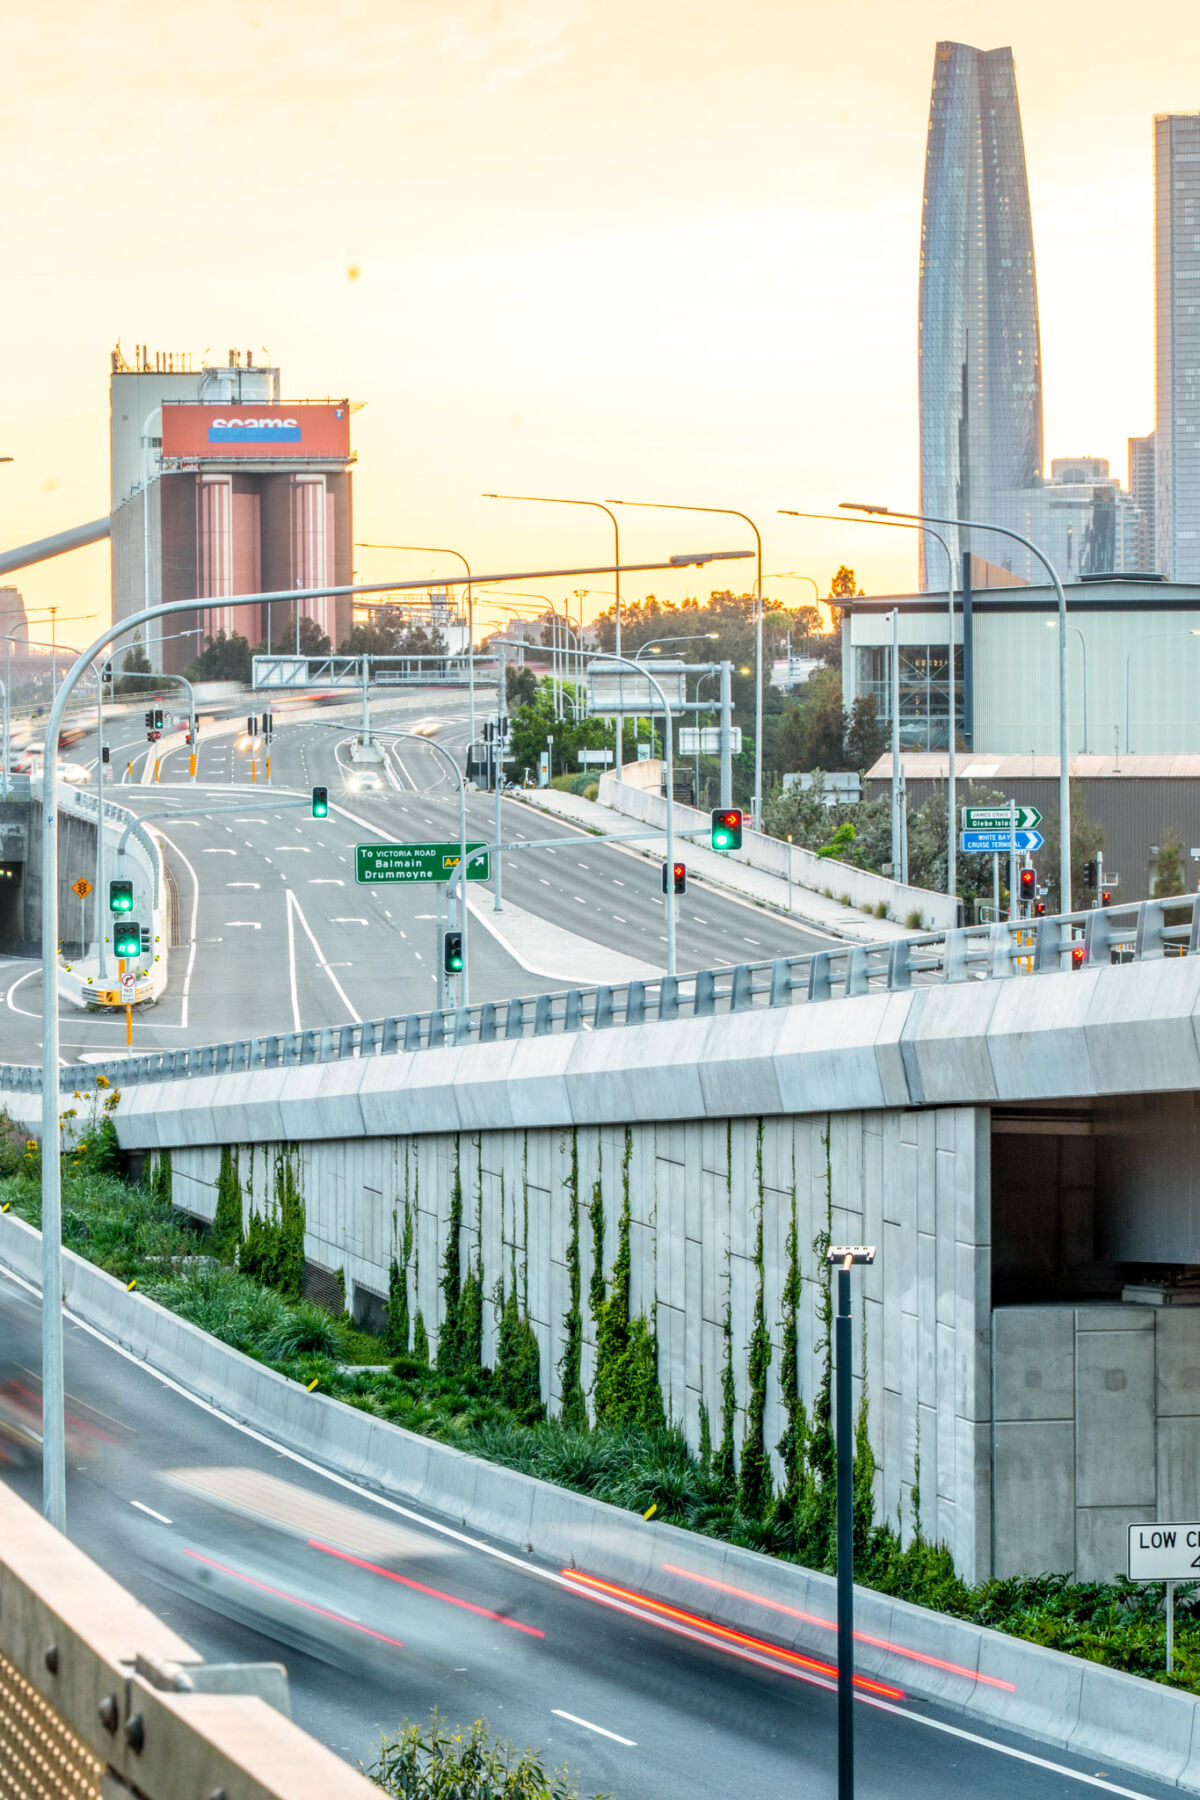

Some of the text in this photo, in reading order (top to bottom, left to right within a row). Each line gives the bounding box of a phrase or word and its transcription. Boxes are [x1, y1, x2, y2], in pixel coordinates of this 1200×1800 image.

[361, 849, 373, 858] To
[376, 850, 412, 858] VICTORIA
[375, 859, 422, 868] Balmain
[444, 857, 463, 867] A4
[365, 871, 433, 880] Drummoyne
[1140, 1530, 1200, 1549] LOW C
